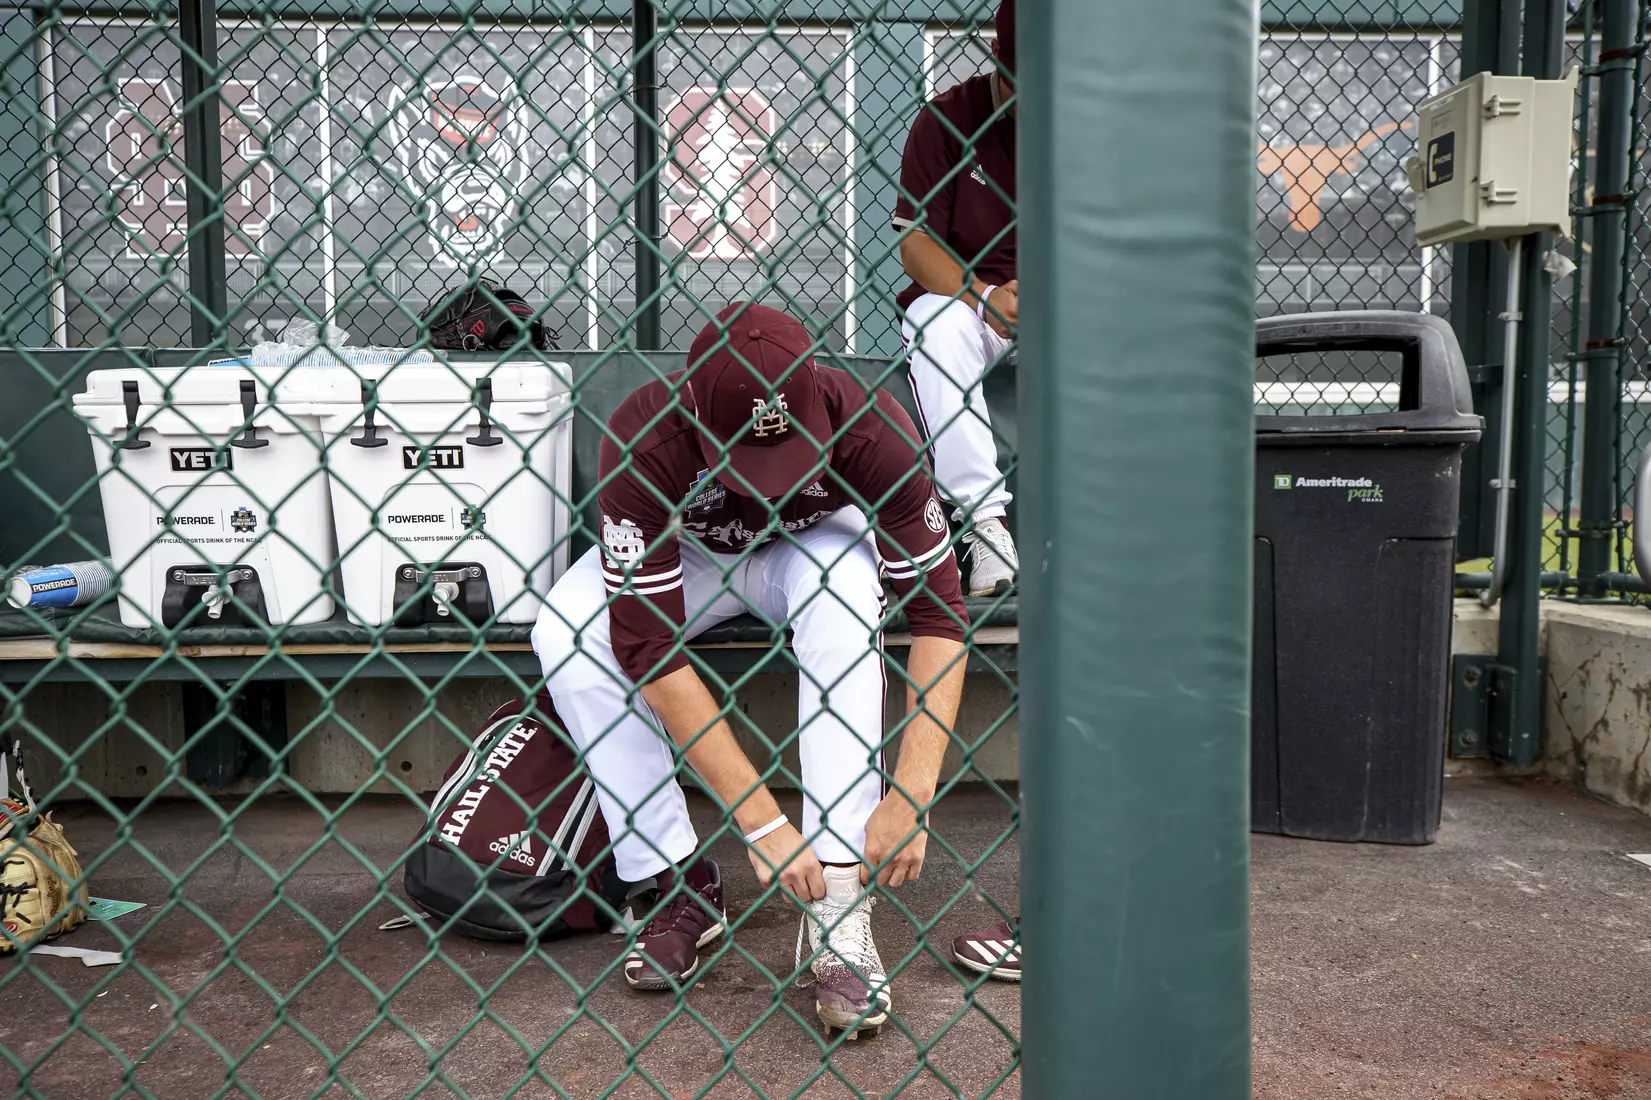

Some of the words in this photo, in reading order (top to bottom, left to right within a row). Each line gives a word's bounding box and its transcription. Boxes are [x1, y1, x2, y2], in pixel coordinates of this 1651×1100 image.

[1434, 152, 1452, 165] PHONE
[1276, 477, 1290, 486] TD
[1296, 477, 1373, 487] Ameritrade
[1347, 484, 1384, 502] park
[156, 516, 216, 525] PWERADE
[388, 514, 446, 524] POWERADE
[33, 579, 76, 592] POWERADE
[440, 784, 490, 846] HAIL
